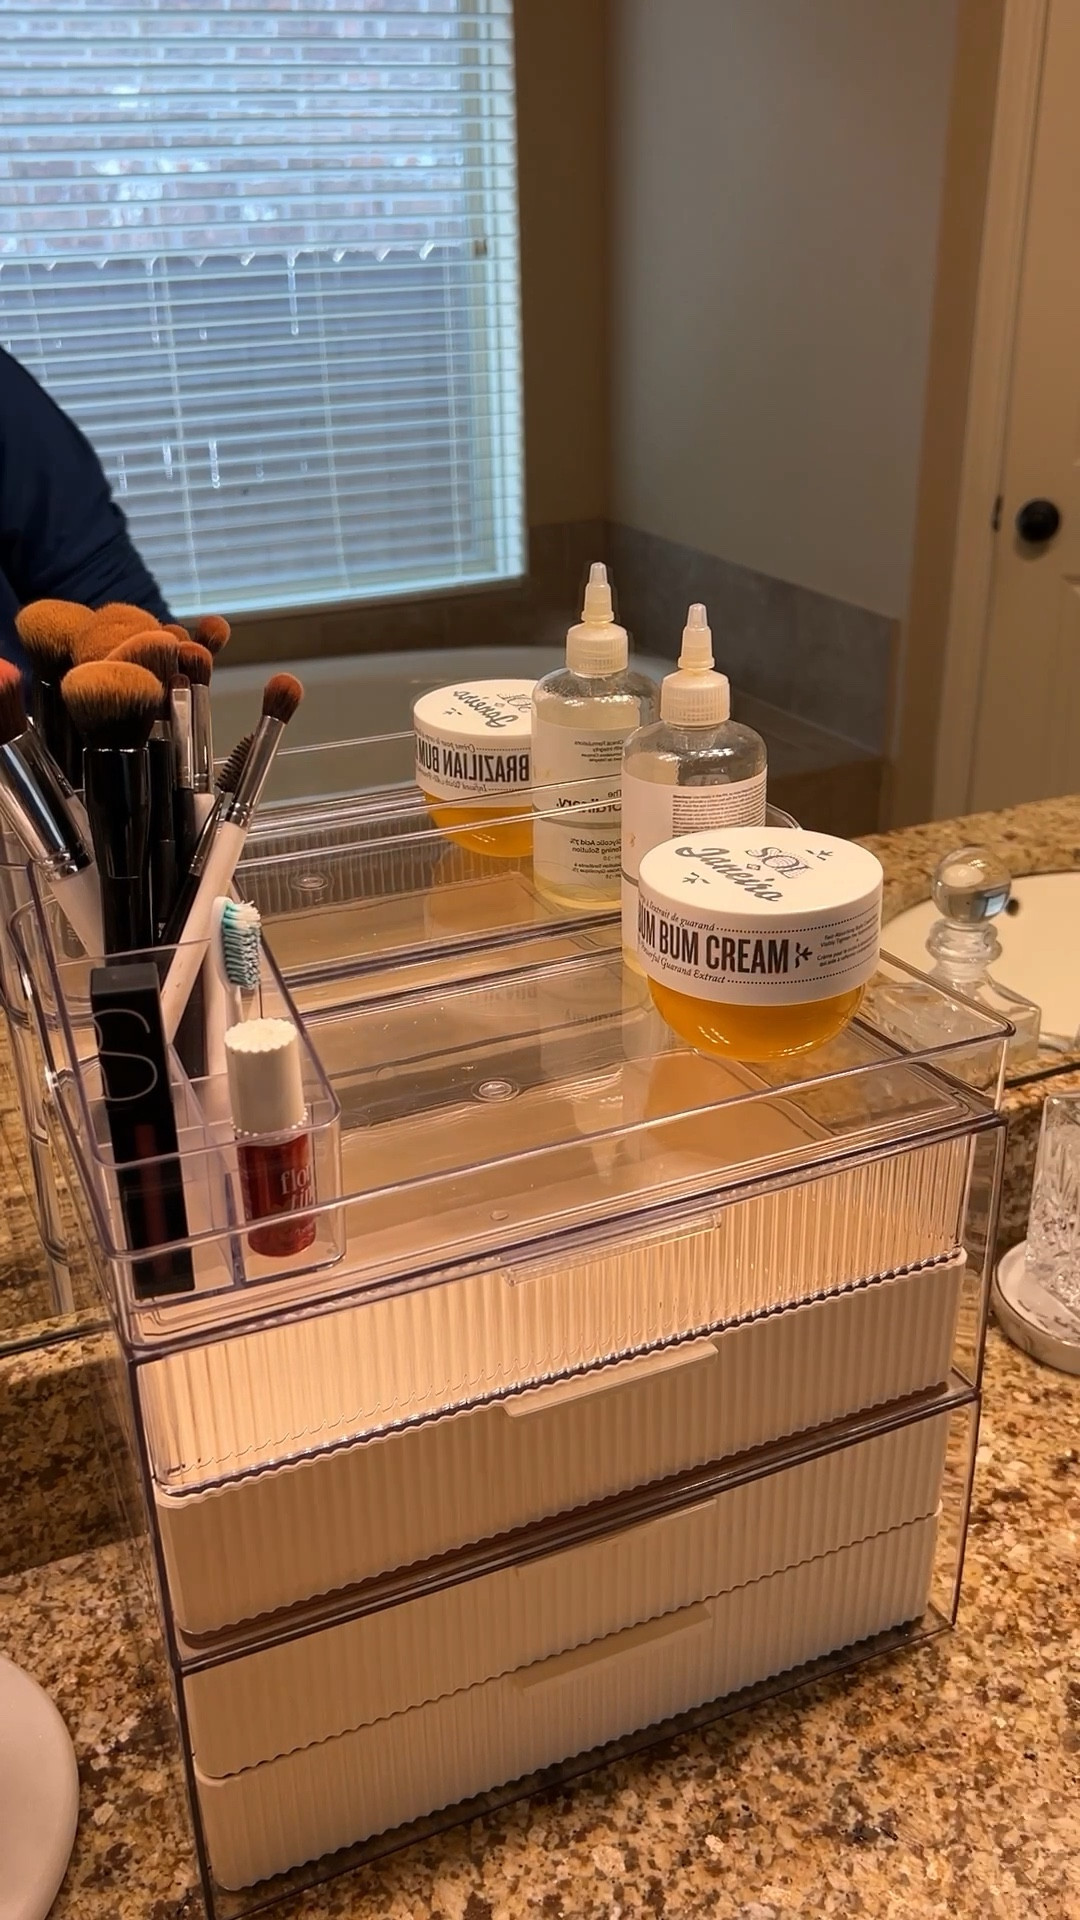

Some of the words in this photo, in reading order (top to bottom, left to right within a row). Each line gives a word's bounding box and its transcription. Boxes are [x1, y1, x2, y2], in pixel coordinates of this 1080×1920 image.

[674, 847, 783, 902] Janeiro
[745, 847, 813, 879] SOL
[659, 919, 699, 967] BUM
[706, 934, 789, 975] CREAM
[693, 968, 726, 984] Extract
